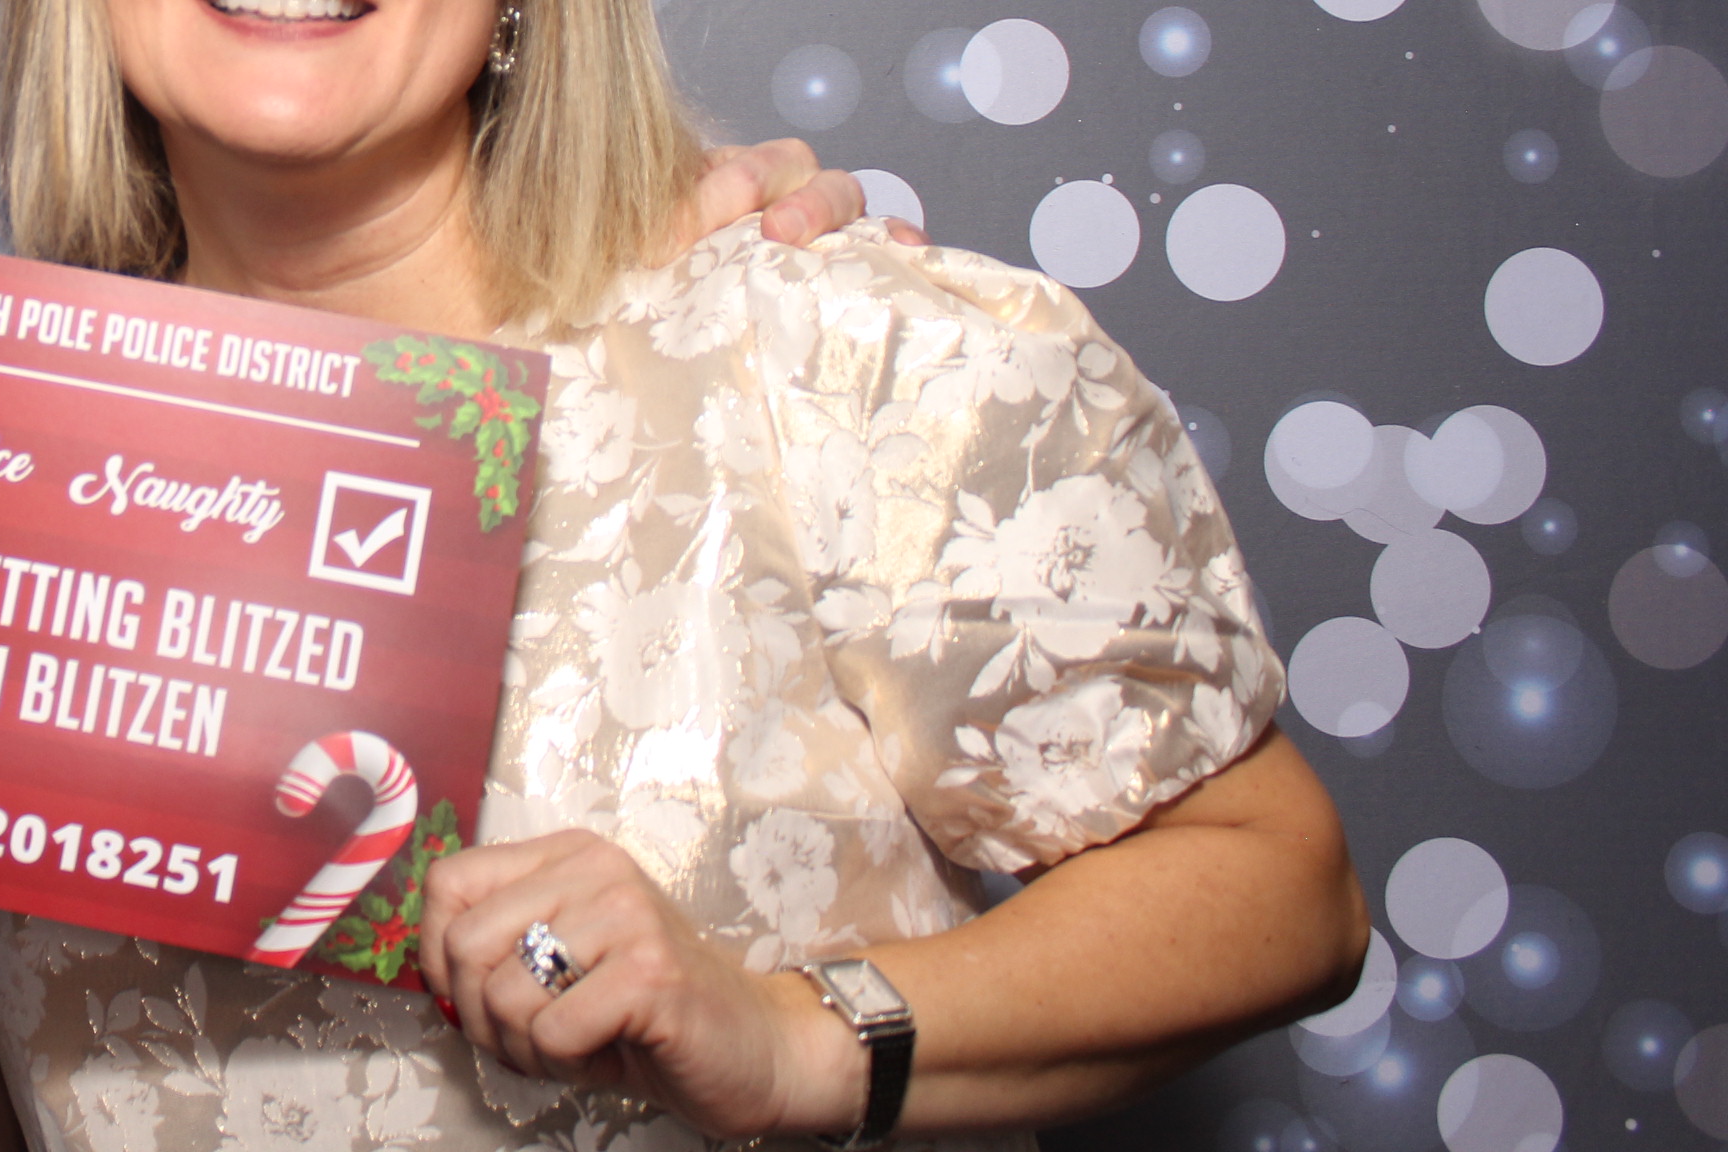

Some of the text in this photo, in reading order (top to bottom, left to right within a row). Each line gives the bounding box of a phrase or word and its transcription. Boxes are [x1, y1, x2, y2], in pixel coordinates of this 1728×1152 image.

[16, 299, 95, 351] POLE
[101, 314, 211, 376] POLICE
[217, 336, 362, 398] DISTRICT
[68, 454, 286, 544] Naughty
[156, 586, 364, 692] BLITZED
[18, 651, 229, 758] BLITZEN
